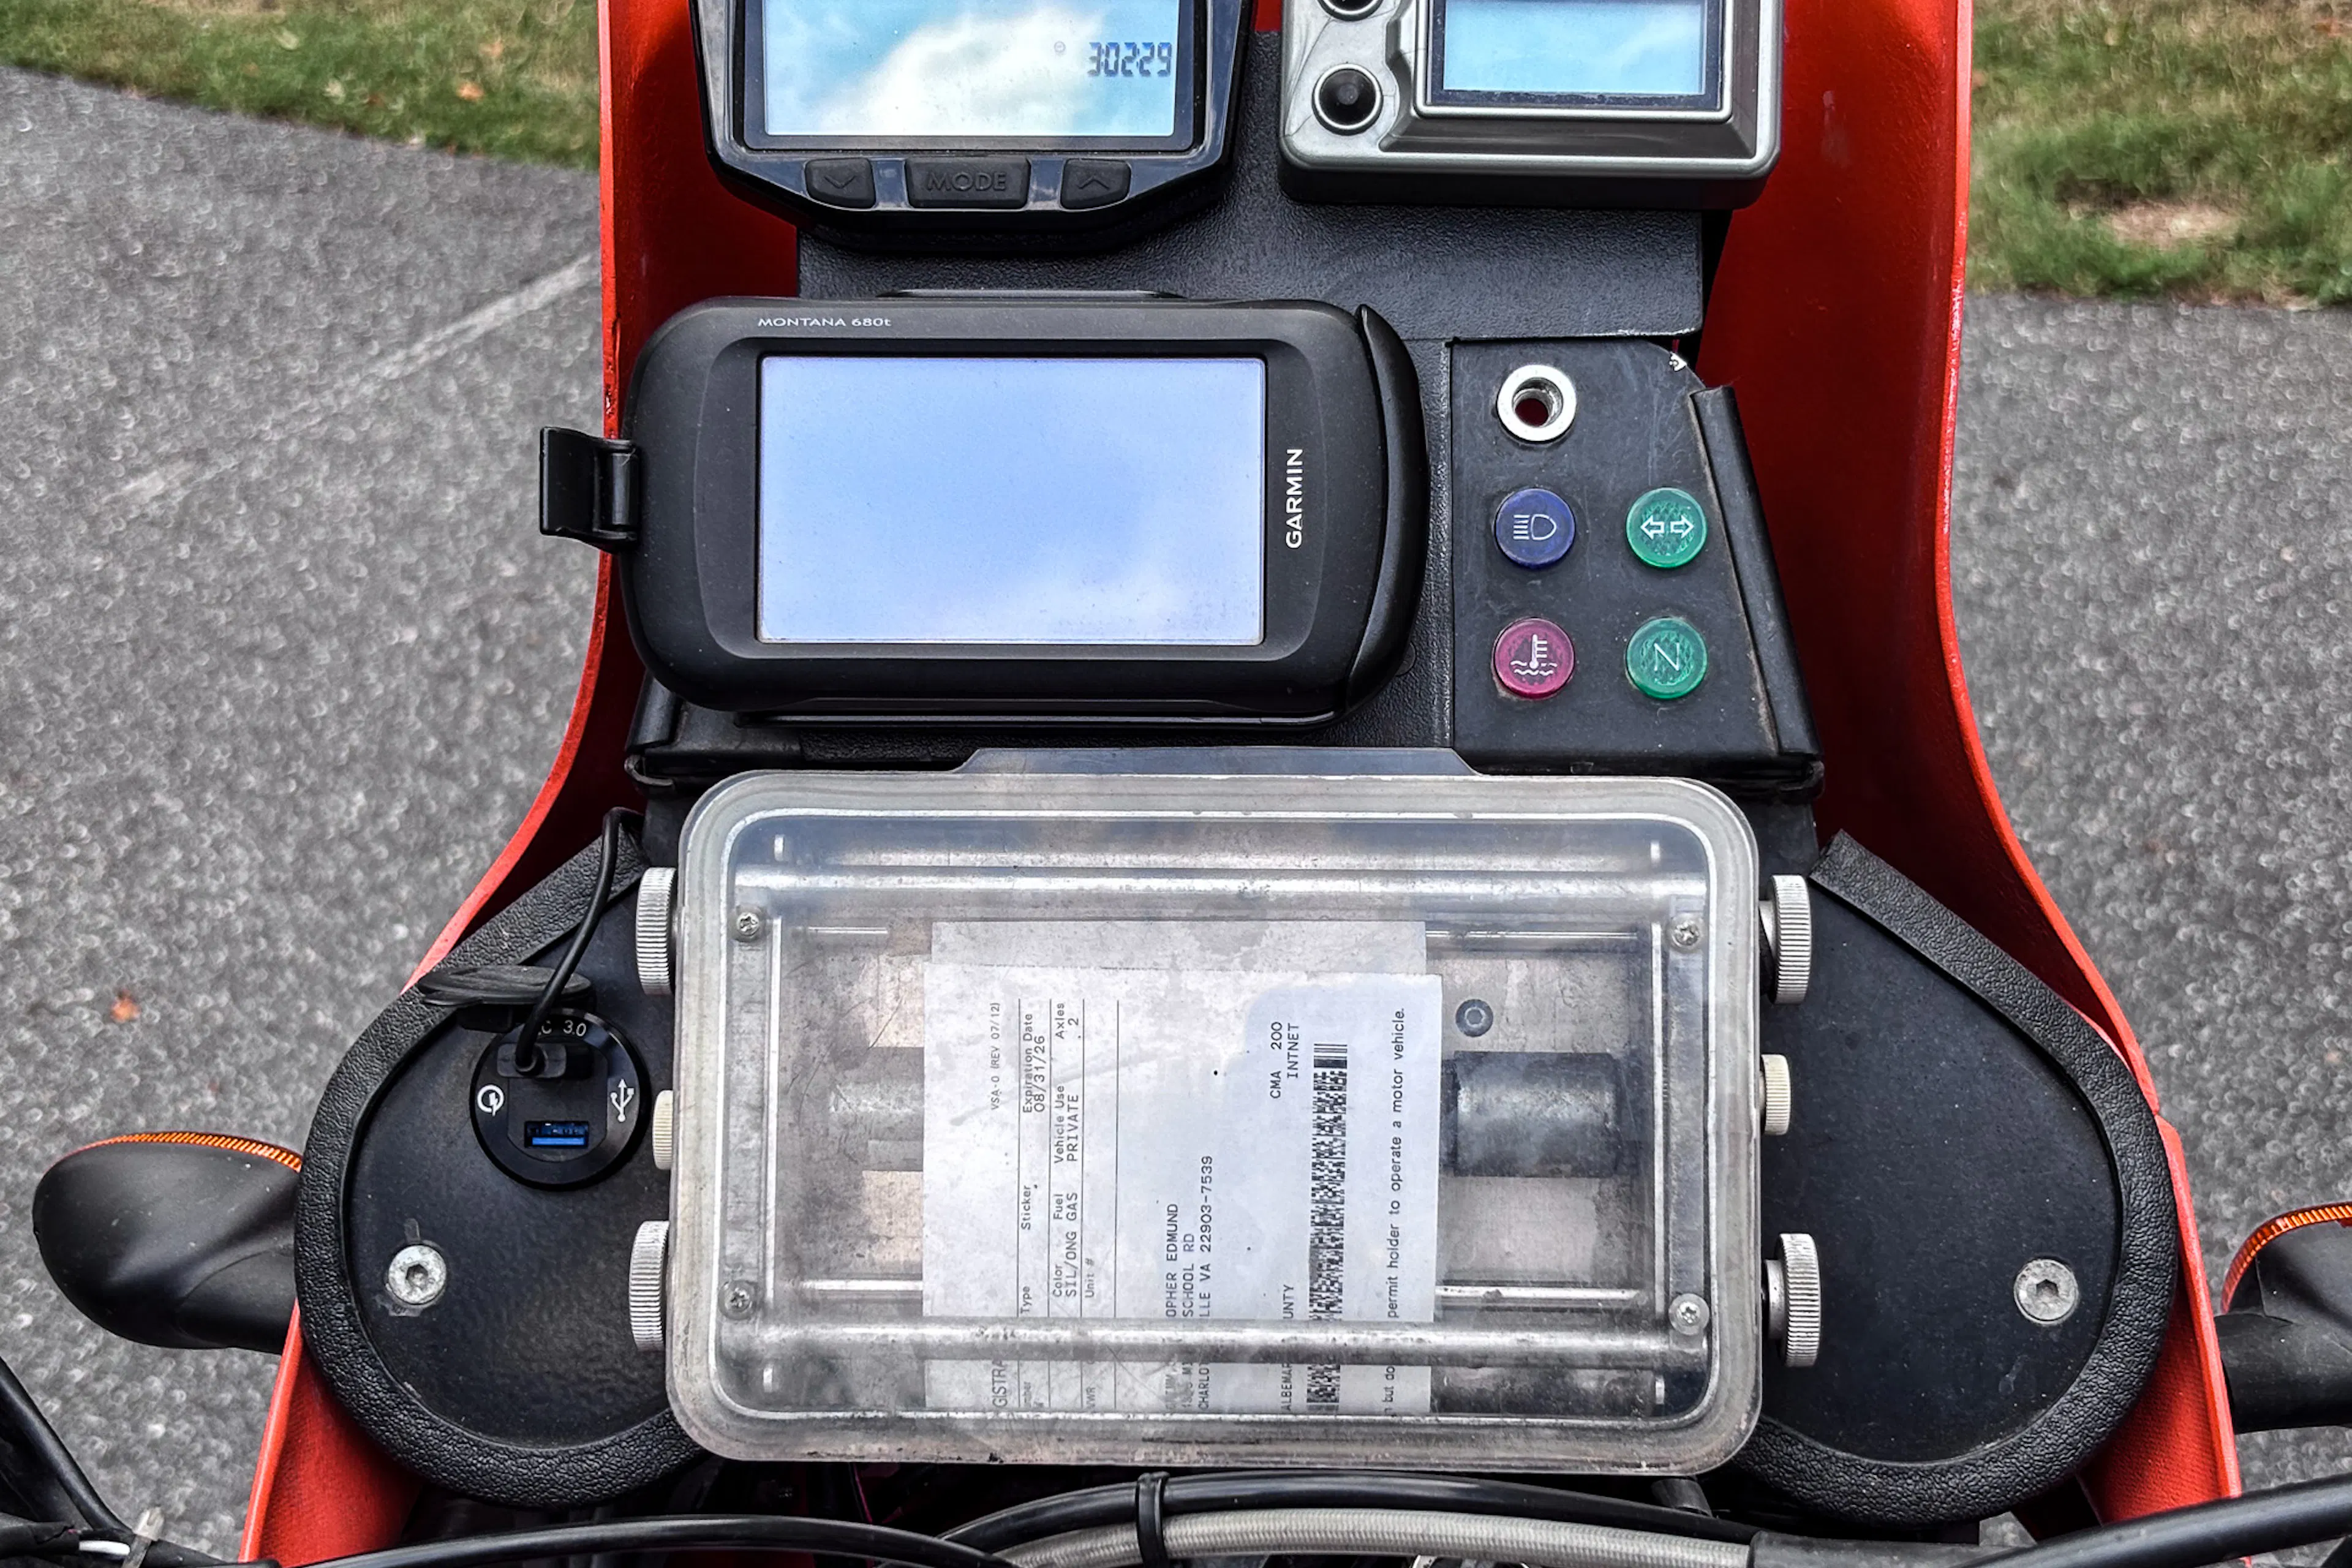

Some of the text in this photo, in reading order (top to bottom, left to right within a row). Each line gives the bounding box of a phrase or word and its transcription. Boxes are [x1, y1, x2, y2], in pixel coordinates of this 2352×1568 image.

[927, 172, 1007, 191] MODE
[758, 317, 892, 327] MONTANA 680t
[1286, 448, 1303, 549] GARMIN
[1653, 642, 1680, 671] N
[563, 1019, 587, 1037] 3.0
[1068, 1017, 1079, 1025] 2
[1391, 1007, 1404, 1059] vehicle.
[1270, 1021, 1283, 1098] CMA 200
[1287, 1022, 1299, 1078] INTNET
[1033, 1034, 1047, 1112] 08/31/26
[1390, 1068, 1403, 1112] motor
[1068, 1093, 1079, 1161] PRIVATE
[1020, 1012, 1035, 1313] Type Sticker Expiration Date
[1053, 1002, 1065, 1297] Color Fuel Vehicle Use Axles
[1390, 1136, 1403, 1191] operate
[1066, 1191, 1078, 1221] GAS
[1200, 1155, 1213, 1252] 22903-7539
[1389, 1200, 1401, 1214] to
[1166, 1203, 1178, 1317] OPHER EDMUND
[1387, 1223, 1400, 1268] holder
[1085, 1273, 1095, 1297] Unit
[1182, 1232, 1195, 1317] SCHOOL RD
[1200, 1262, 1211, 1281] VA
[1199, 1291, 1210, 1317] LLE
[1283, 1283, 1294, 1319] UNTY
[1386, 1275, 1399, 1318] permit
[992, 1359, 1008, 1406] GISTRA
[1384, 1366, 1395, 1380] do
